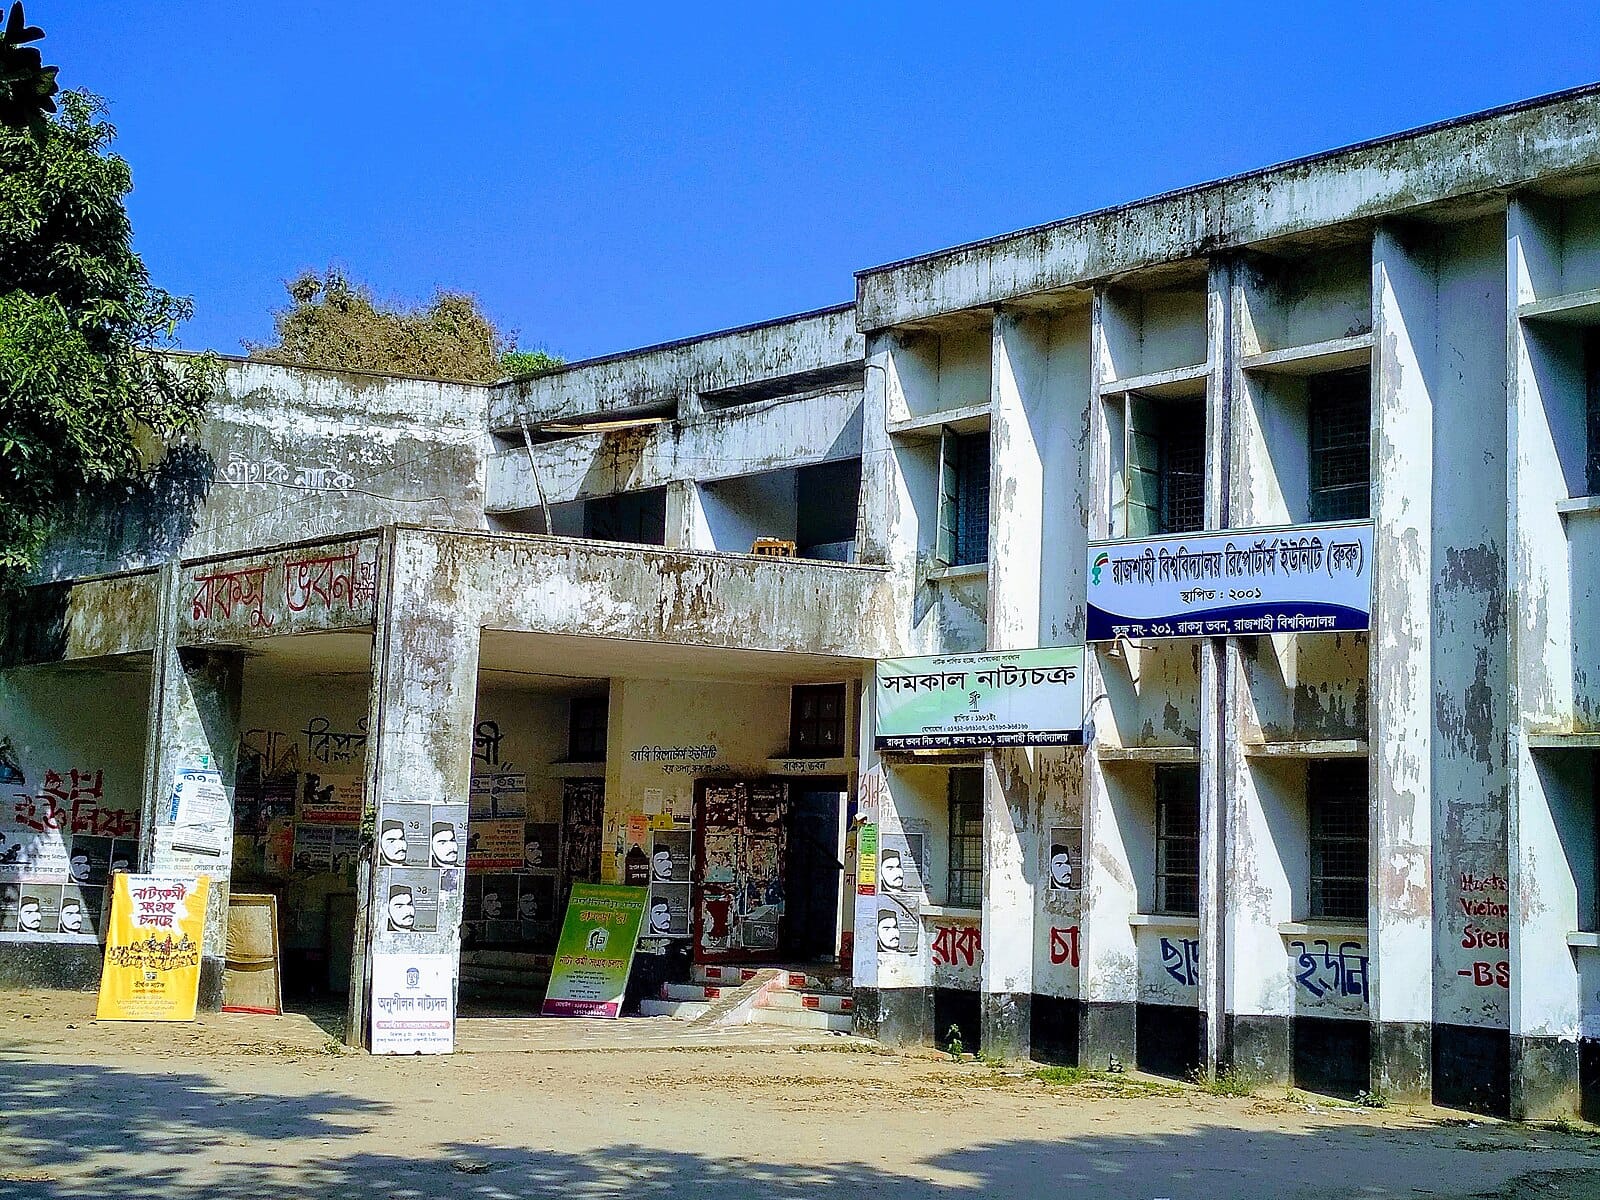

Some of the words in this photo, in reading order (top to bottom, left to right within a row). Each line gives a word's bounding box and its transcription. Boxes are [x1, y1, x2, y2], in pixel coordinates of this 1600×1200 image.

[1112, 547, 1154, 586] রাজশাহী
[1159, 546, 1222, 581] বিশ্ববিদ্যালয়
[1279, 536, 1323, 577] ইউনিটি
[1327, 538, 1364, 579] (রুরু)
[1180, 589, 1216, 605] স্থাপিত
[1229, 588, 1262, 600] ২০০১
[1178, 621, 1203, 635] রাকসু
[1205, 620, 1230, 634] ভবন,
[1233, 616, 1273, 631] রাজশাহী
[1277, 613, 1336, 630] বিশ্ববিদ্যালয়
[881, 671, 969, 694] সমকাল
[975, 664, 1078, 689] নাট্যচক্র
[886, 738, 905, 748] রাকসু
[906, 737, 921, 746] ভবন
[996, 733, 1025, 744] রাজশাহী
[1026, 732, 1069, 743] বিশ্ববিদ্যালয়
[631, 746, 651, 762] রাবি
[688, 745, 718, 761] ইউনিটি
[783, 761, 806, 773] রাকসু
[808, 761, 826, 770] ভবন
[1460, 897, 1509, 917] Victor
[139, 914, 173, 928] চলছে
[932, 926, 983, 967] রাক
[1050, 926, 1080, 968] চা
[1291, 939, 1369, 1004] ইউনি
[1458, 961, 1509, 989] -BS
[378, 992, 415, 1015] অনুশীলন
[416, 993, 448, 1012] নাট্যদল
